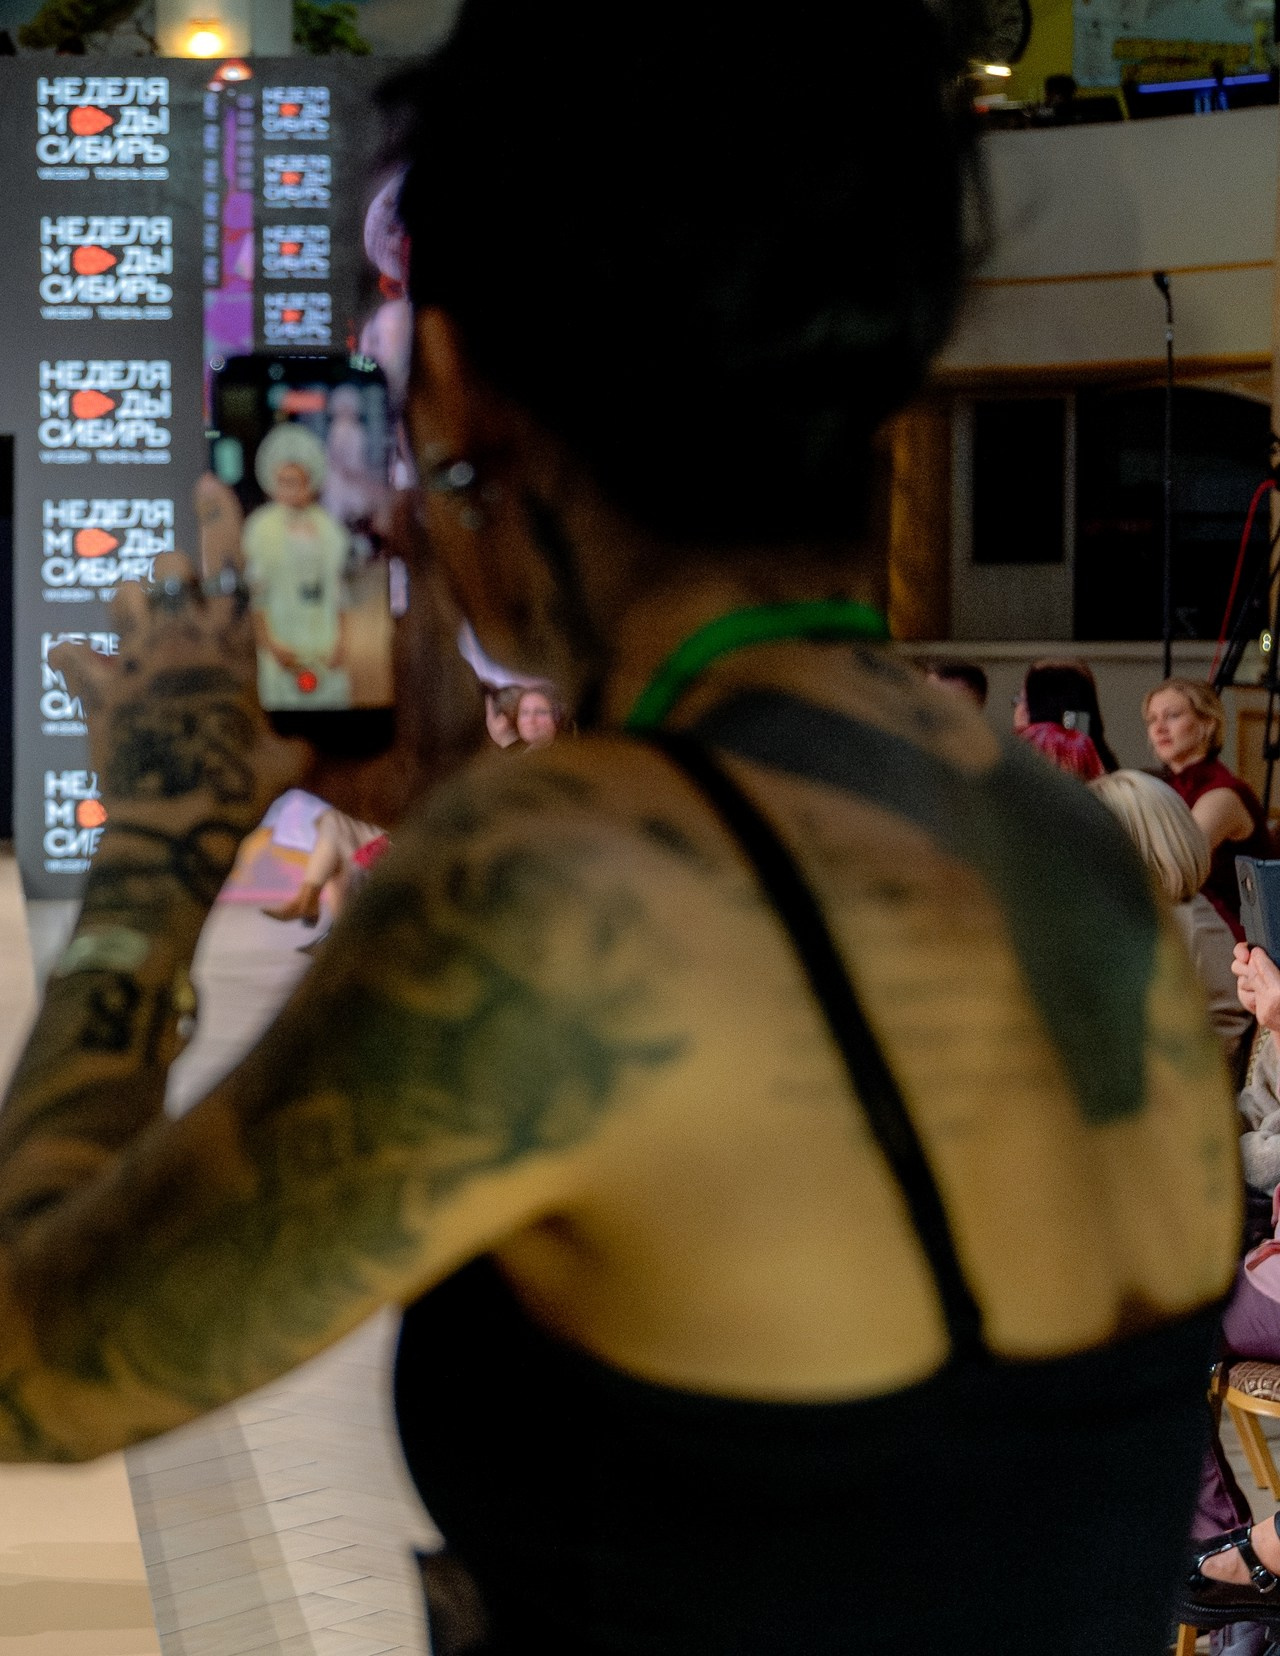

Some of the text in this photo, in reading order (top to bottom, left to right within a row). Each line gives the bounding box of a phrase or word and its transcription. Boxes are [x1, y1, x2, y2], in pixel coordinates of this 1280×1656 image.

[36, 76, 169, 107] НЕДЕЛЯ
[36, 135, 169, 164] СИБИРЬ
[40, 216, 172, 247] НЕДЕЛЯ
[39, 274, 173, 304] СИБИРЬ
[39, 360, 171, 391] НЕДЕЛЯ
[38, 418, 171, 448] СИБИРЬ
[42, 499, 174, 530] НЕДЕЛЯ
